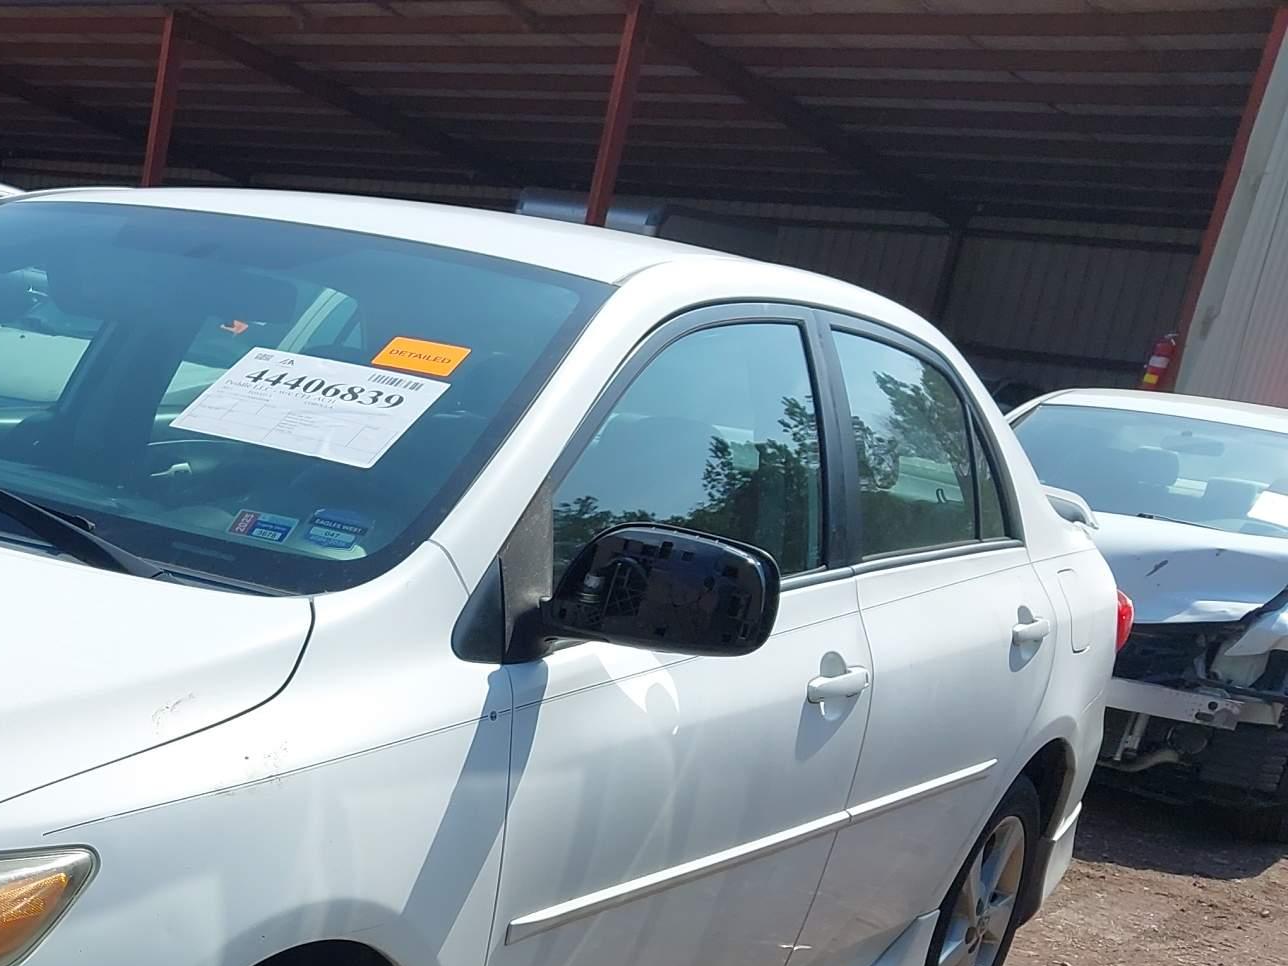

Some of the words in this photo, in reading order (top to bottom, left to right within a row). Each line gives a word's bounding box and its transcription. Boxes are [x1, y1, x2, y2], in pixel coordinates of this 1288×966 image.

[388, 348, 452, 364] DETAILED
[245, 368, 405, 409] 44406839
[235, 513, 255, 532] 2025
[315, 517, 342, 530] EAGLES
